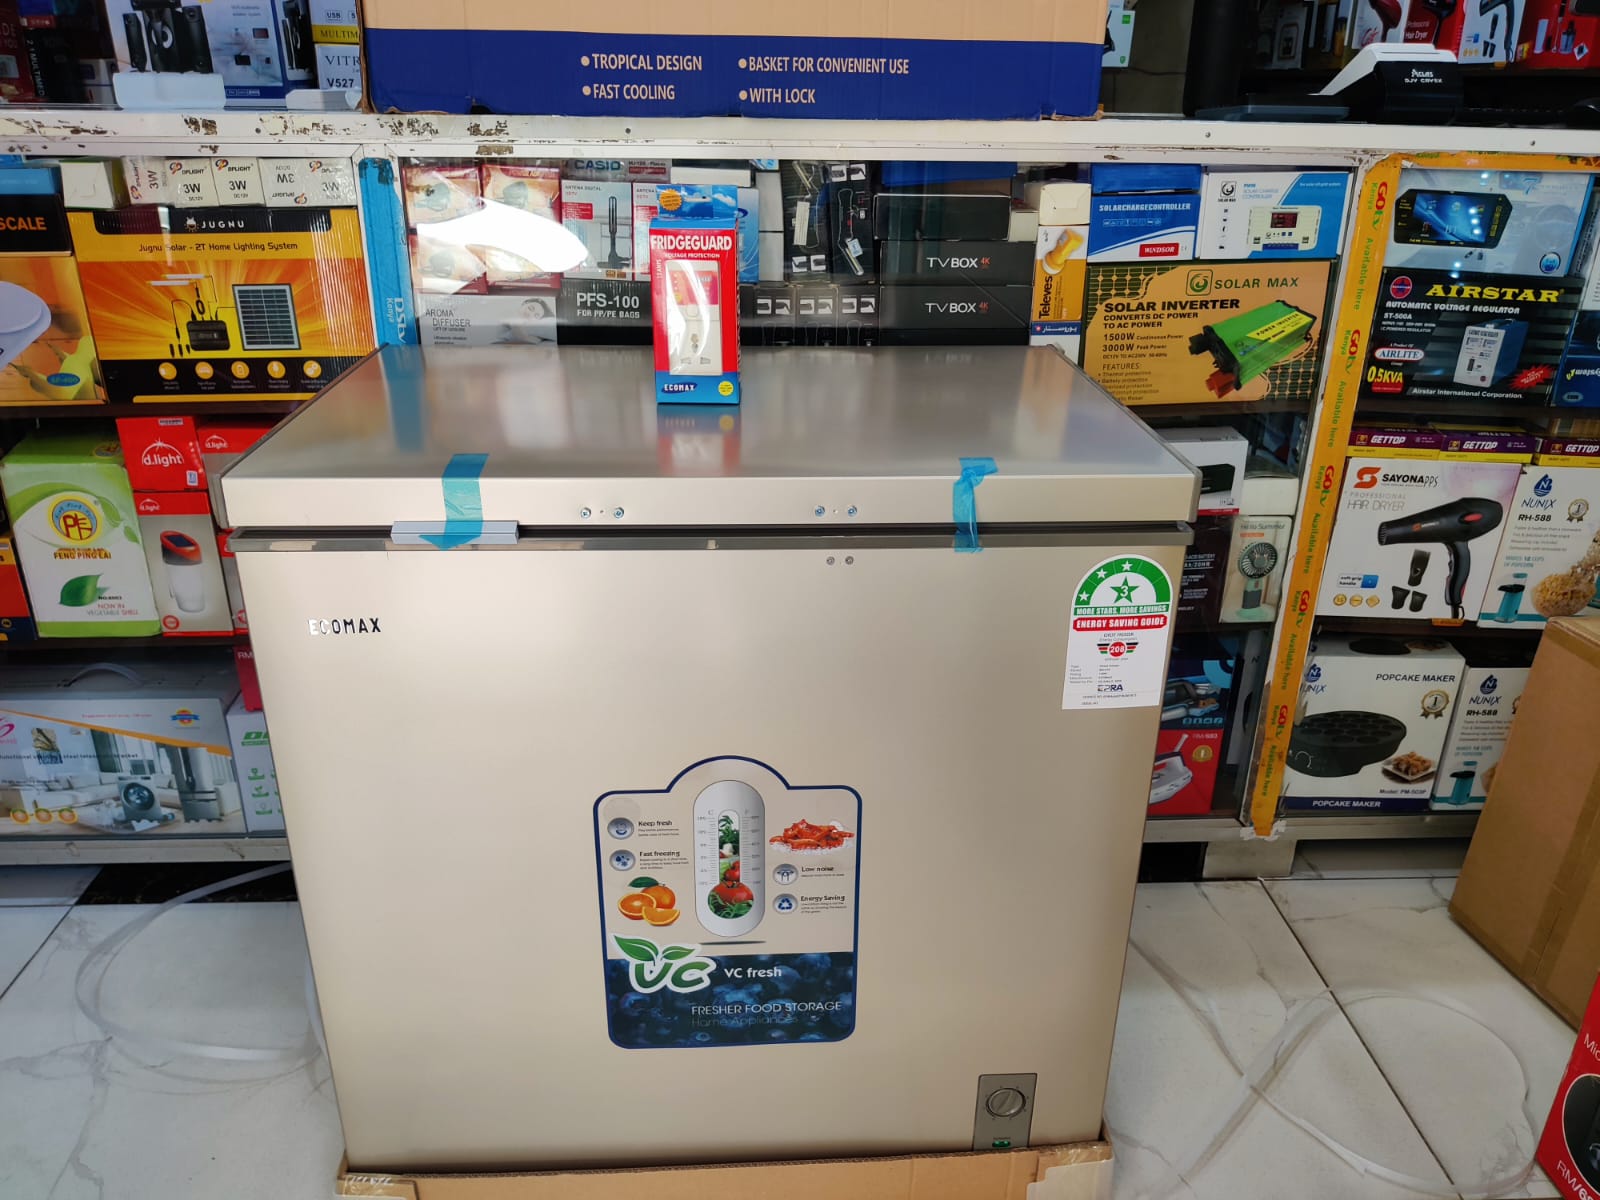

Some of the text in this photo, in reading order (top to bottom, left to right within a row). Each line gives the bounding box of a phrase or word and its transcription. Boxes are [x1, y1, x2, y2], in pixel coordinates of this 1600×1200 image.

[593, 53, 702, 71] TROPICAL DESIGN
[749, 56, 909, 74] BASKET FOR CONVENIENT USE
[327, 78, 354, 88] V527
[593, 84, 675, 100] FAST COOLING
[750, 88, 816, 104] WITH LOCK
[574, 160, 621, 170] CASIO
[149, 170, 159, 190] 3W
[276, 173, 294, 184] 3W
[183, 183, 201, 194] 3W
[228, 180, 247, 191] 3W
[322, 182, 340, 192] 3W
[0, 217, 47, 231] SCALE
[201, 220, 245, 229] JUGNU
[139, 244, 163, 254] Jugnu
[233, 242, 265, 252] Lighting
[268, 242, 298, 251] System
[650, 234, 732, 250] FRIDGEGUARD
[1354, 238, 1374, 310] Available here
[1214, 277, 1299, 289] SOLAR MAX
[1039, 276, 1052, 318] Televes
[1426, 284, 1560, 302] AIRSTAR
[576, 292, 640, 310] PFS-100
[978, 302, 989, 310] 4K
[1104, 299, 1240, 312] SOLAR INVERTER
[386, 298, 394, 324] Kenya
[426, 309, 454, 317] AROMA
[1386, 301, 1520, 314] AUTOMATIC VOLTAGE REGULATOR
[578, 310, 591, 318] FOR
[594, 310, 616, 318] PP/PE
[1384, 312, 1412, 320] ST-500A
[394, 298, 406, 344] DStv
[432, 318, 471, 328] DIFFUSER
[1104, 333, 1135, 341] 1500W
[1102, 344, 1135, 352] 3000W
[1367, 366, 1404, 384] 0.5KVA
[1437, 388, 1480, 398] International
[1482, 390, 1522, 400] Corporation
[1328, 380, 1346, 448] Available here
[1370, 434, 1406, 445] GETTOP
[1462, 440, 1498, 450] GETTOP
[1565, 444, 1600, 454] GETTOP
[143, 454, 182, 467] d.light
[1350, 491, 1406, 499] PROFESSIONAL
[1347, 500, 1406, 512] HAIR DRYER
[1521, 497, 1557, 510] NUNIX
[1518, 514, 1552, 522] RH-588
[1304, 513, 1320, 574] Available here
[54, 552, 112, 560] FENG PING LAI
[1120, 586, 1129, 598] 3
[1096, 606, 1118, 615] STARS,
[1120, 606, 1138, 614] MORE
[308, 618, 382, 636] ECOMAX
[1076, 617, 1164, 628] ENERGY SAVING GUIDE
[1376, 674, 1456, 682] POPCAKE MAKER
[1469, 696, 1502, 706] NUNIX
[1352, 800, 1381, 808] MAKER
[634, 961, 711, 990] VC
[724, 966, 782, 978] VC fresh
[692, 1002, 842, 1016] FRESHER FOOD STORAGE
[692, 1015, 799, 1027] Home Appliances
